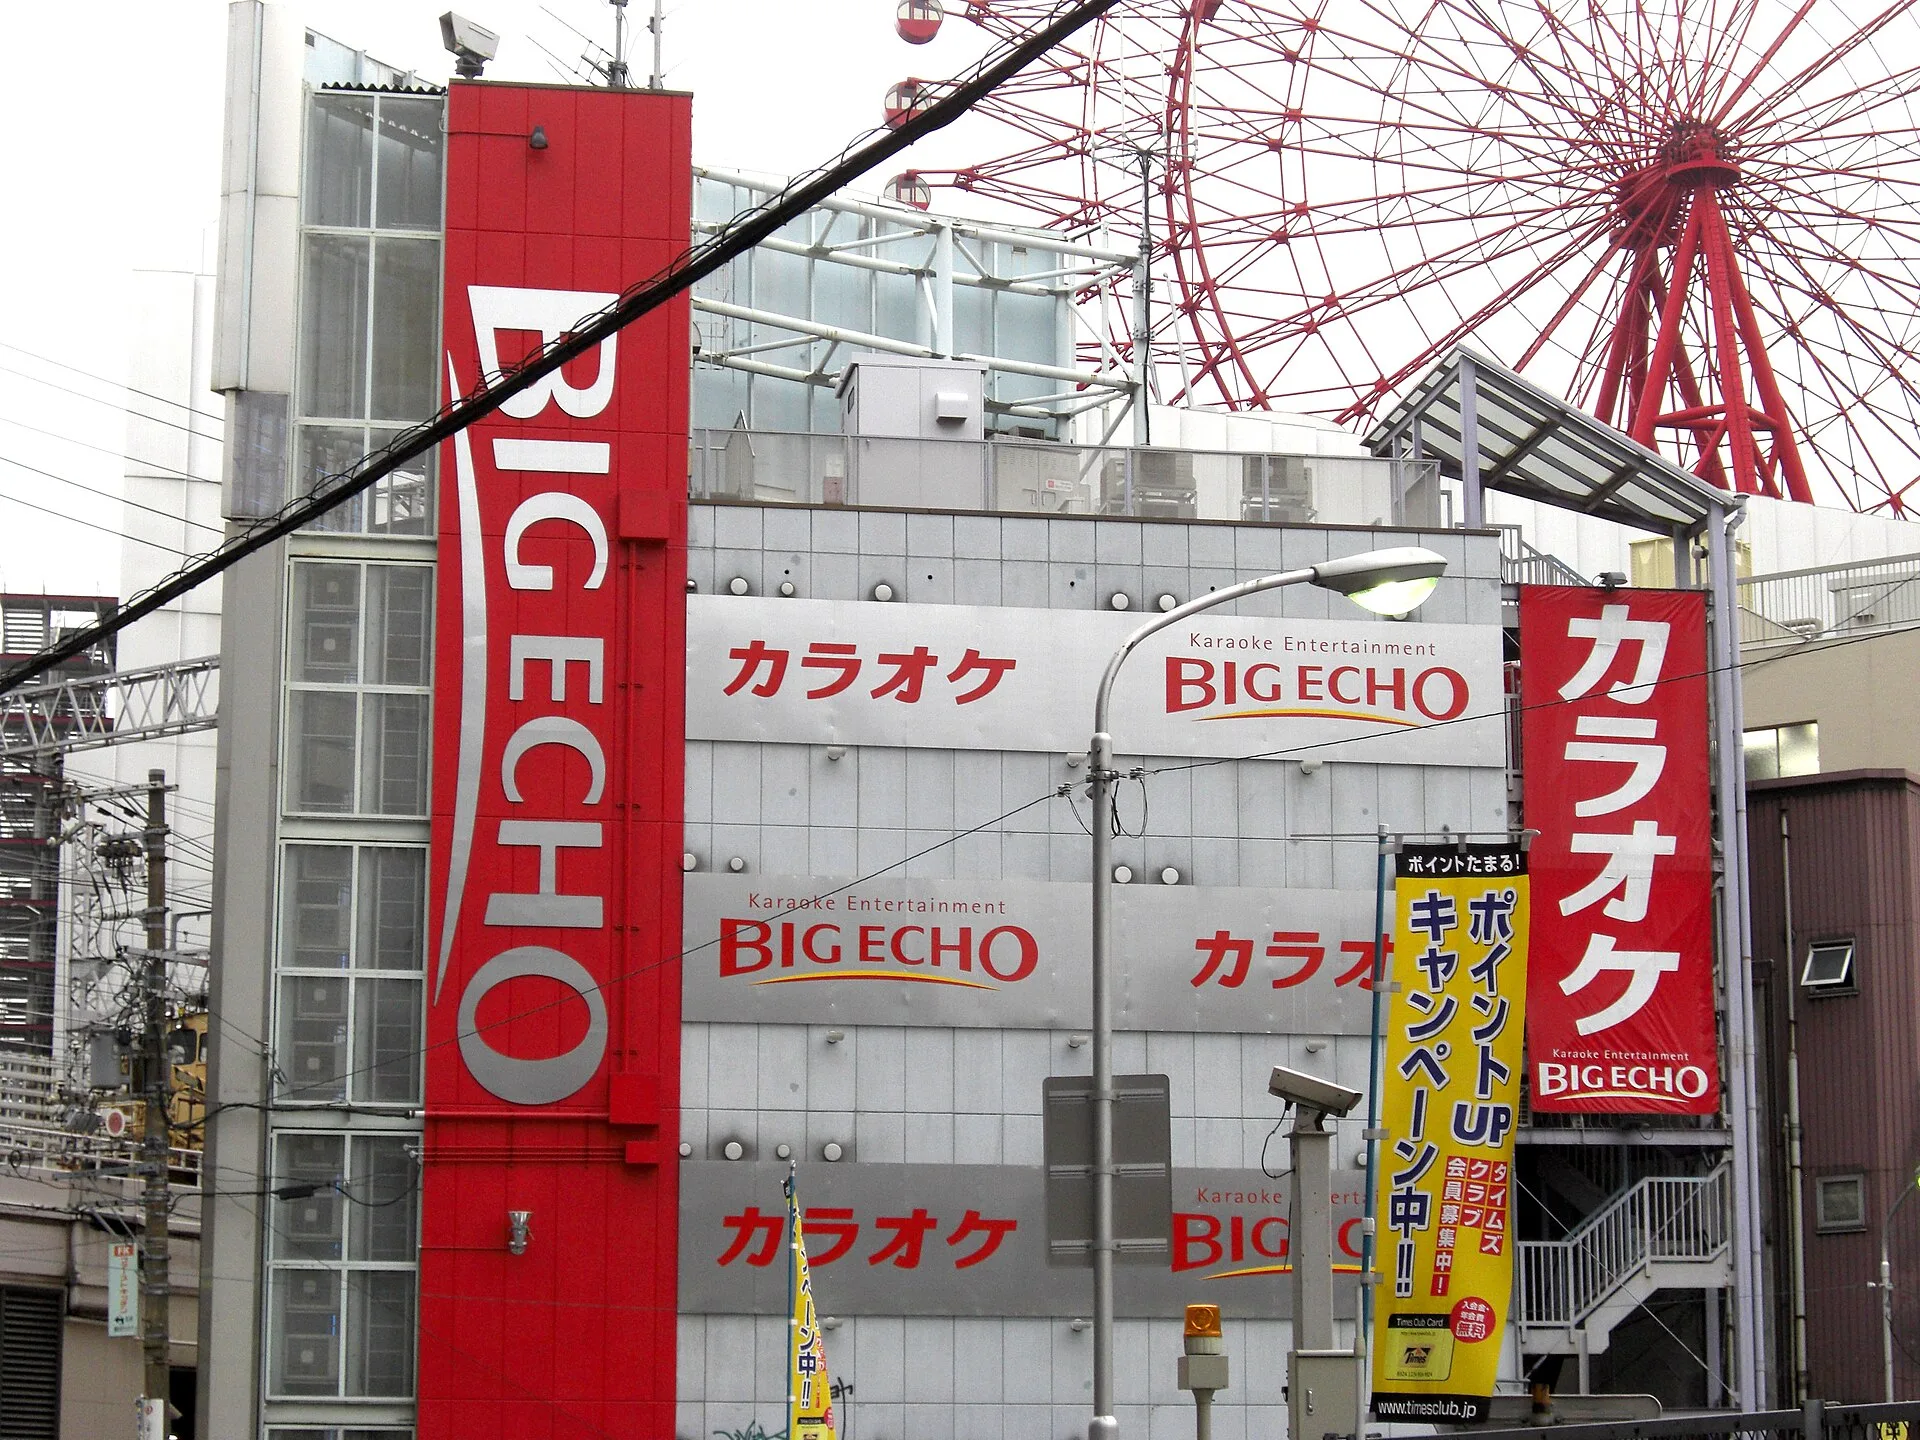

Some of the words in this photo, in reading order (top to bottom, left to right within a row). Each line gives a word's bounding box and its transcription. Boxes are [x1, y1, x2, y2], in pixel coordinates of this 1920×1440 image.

[468, 285, 620, 591] BIG
[723, 639, 1017, 706] カラオケ
[1189, 633, 1273, 651] Karaoke
[1284, 636, 1436, 656] Entertainment
[1165, 655, 1282, 714] BIG
[1297, 664, 1470, 721] ECHO
[1558, 603, 1681, 1037] カラオケ
[457, 635, 607, 1105] ECHO
[1408, 853, 1520, 874] ポイントたまる!
[748, 892, 836, 912] Karaoke
[847, 895, 1006, 916] Entertainment
[718, 917, 842, 978] BIG
[858, 924, 1040, 982] ECHO
[1190, 929, 1397, 989] カラオ
[1538, 1062, 1604, 1096] BIG
[1611, 1065, 1709, 1098] ECHO
[1552, 1048, 1600, 1060] Karaoke
[1604, 1049, 1690, 1062] Entertainment
[1196, 1187, 1283, 1205] Karaoke
[1436, 1157, 1467, 1294] 会員募集中!
[1464, 1161, 1489, 1227] クラブ
[1480, 1161, 1508, 1255] タイムズ
[716, 1206, 1018, 1270] カラオケ
[1170, 1211, 1291, 1273] BIG
[1426, 1317, 1444, 1328] Card
[1378, 1400, 1477, 1419] www.timesclub.jp
